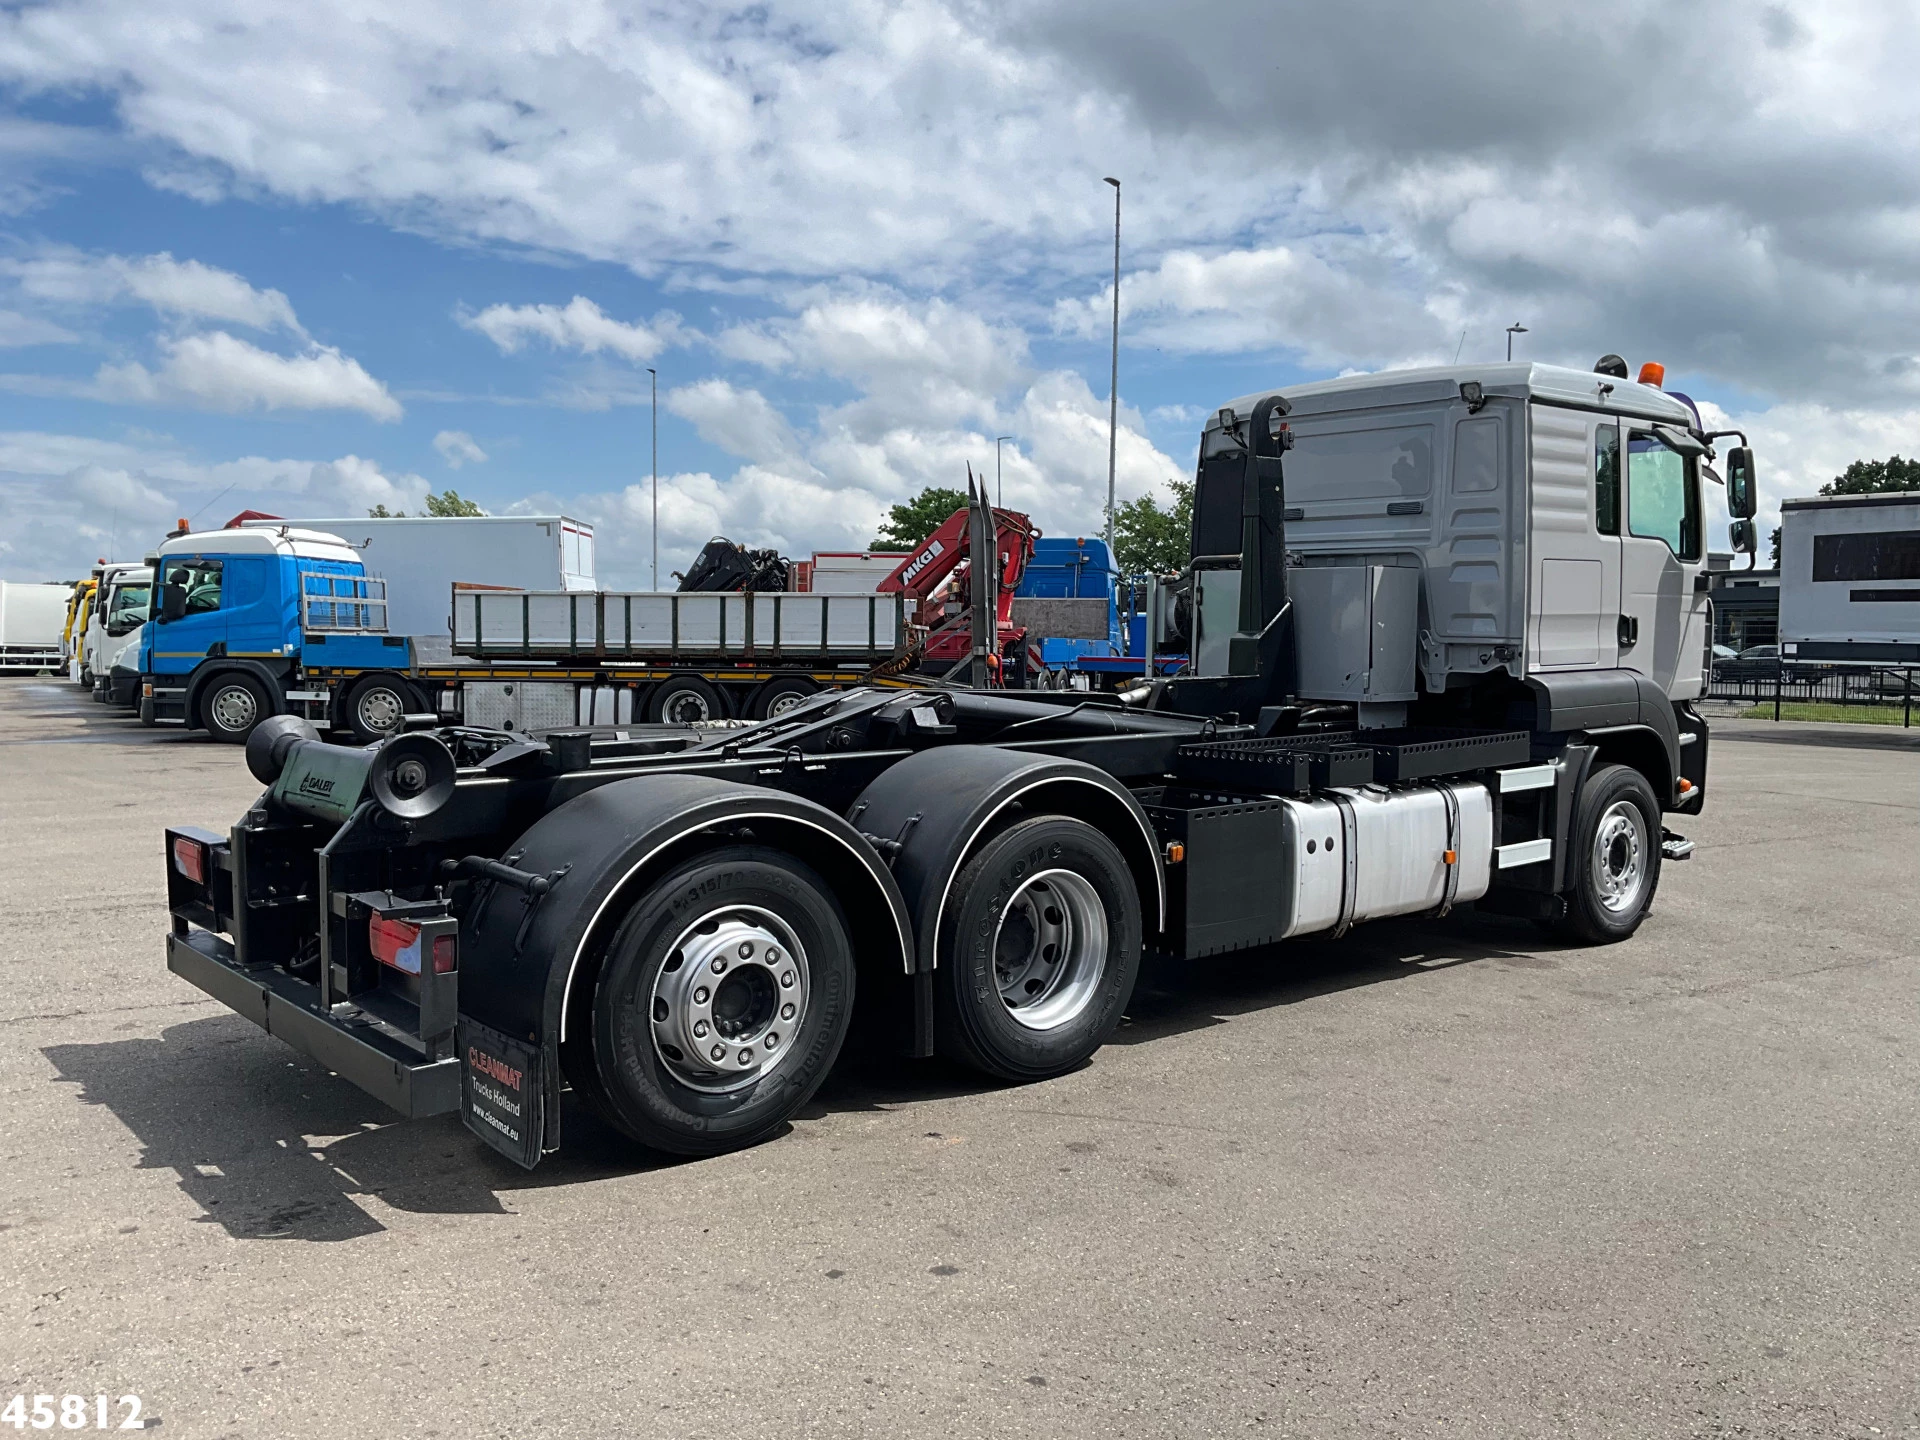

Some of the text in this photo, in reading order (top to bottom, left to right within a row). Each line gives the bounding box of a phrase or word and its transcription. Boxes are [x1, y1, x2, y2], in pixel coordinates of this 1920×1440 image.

[902, 550, 934, 587] MKG
[801, 969, 842, 1077] Continental
[469, 1046, 522, 1092] CLEANMAT
[472, 1076, 520, 1117] Trucks Holland
[472, 1102, 519, 1141] www.cleanmat.eu
